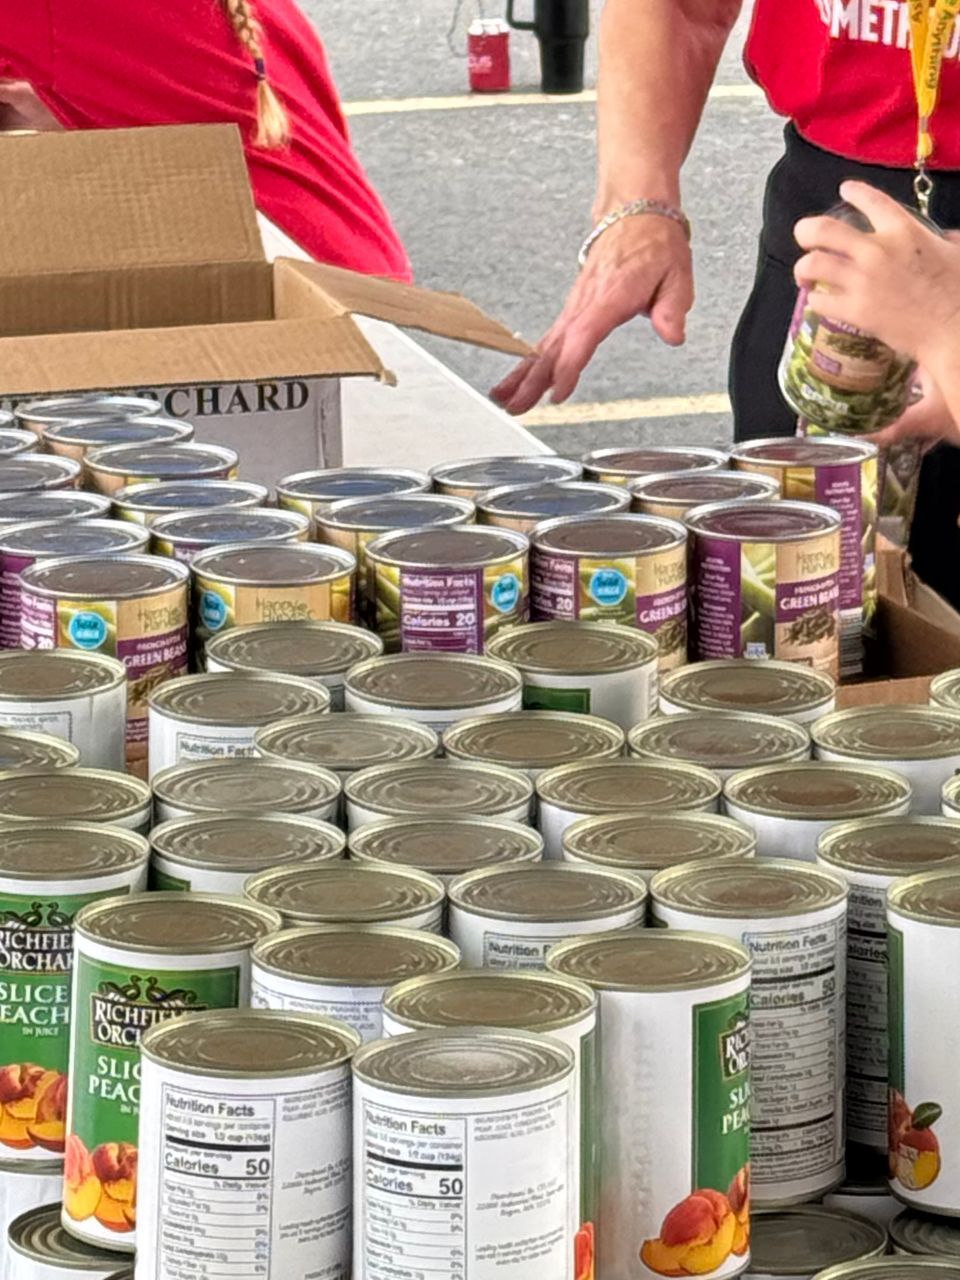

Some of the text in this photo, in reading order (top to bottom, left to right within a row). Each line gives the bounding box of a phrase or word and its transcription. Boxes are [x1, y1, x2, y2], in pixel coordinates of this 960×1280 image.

[556, 598, 573, 611] 20
[780, 593, 817, 611] GREEN
[403, 613, 476, 627] Calories 20
[122, 650, 162, 668] GREEN
[488, 942, 540, 956] Nutrition
[750, 939, 800, 953] Nutrition
[751, 992, 804, 1006] Calories
[97, 1055, 142, 1080] SLIC
[166, 1093, 255, 1117] Nutrition Facts
[366, 1109, 446, 1136] Nutrition Facts
[165, 1153, 270, 1176] Calories 50
[366, 1170, 463, 1195] Calories 50
